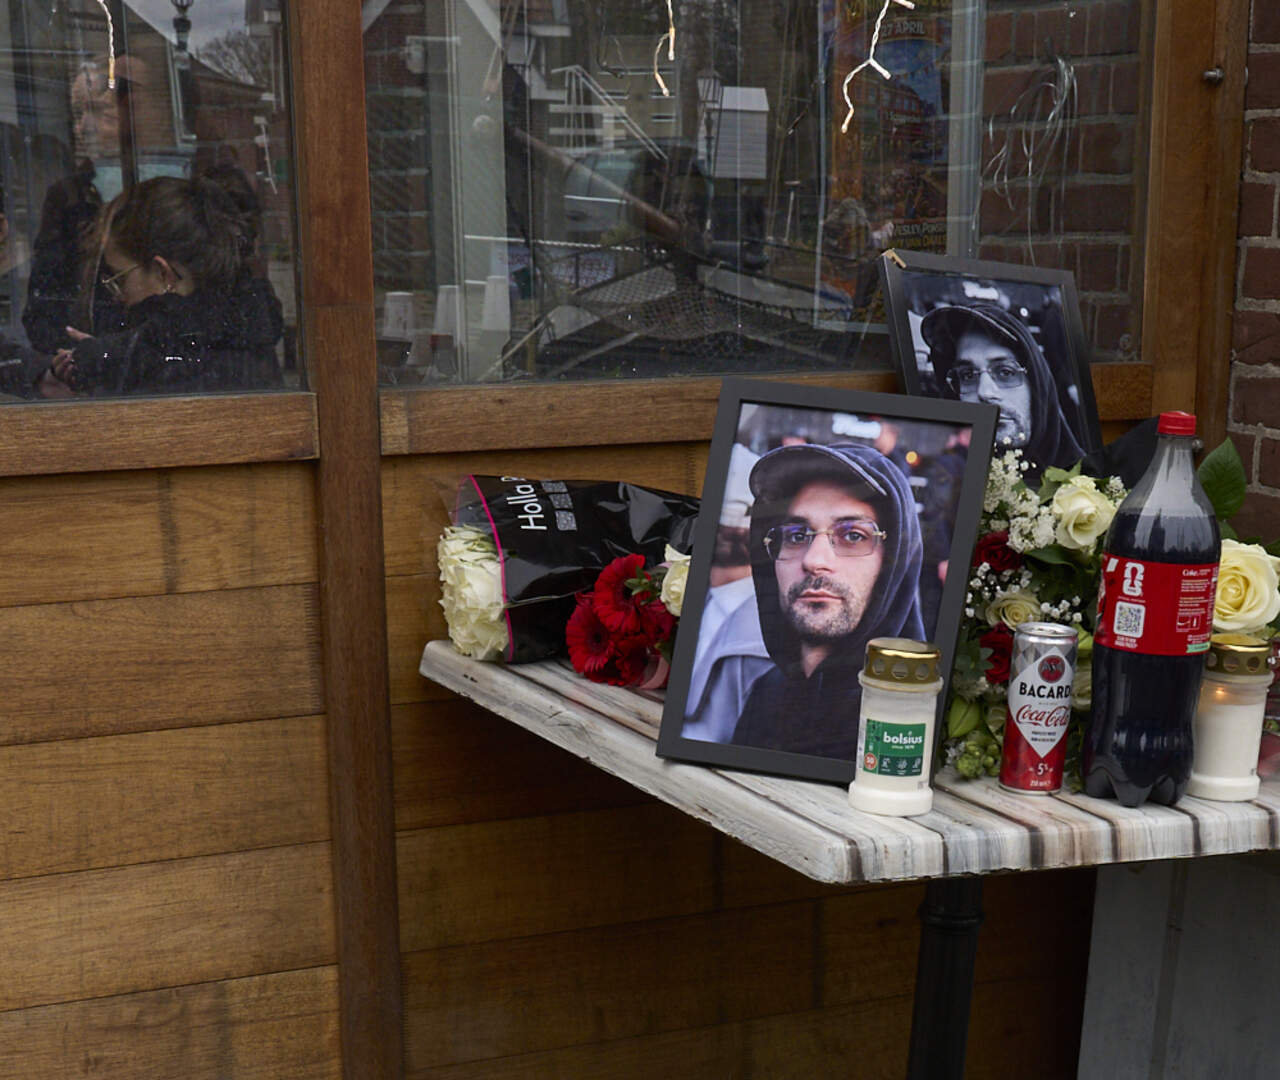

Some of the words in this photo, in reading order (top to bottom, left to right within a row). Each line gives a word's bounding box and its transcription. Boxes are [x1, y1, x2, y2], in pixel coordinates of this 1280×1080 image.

[895, 20, 925, 35] APRIL
[1019, 682, 1072, 699] BACARD
[883, 730, 923, 745] bolsius
